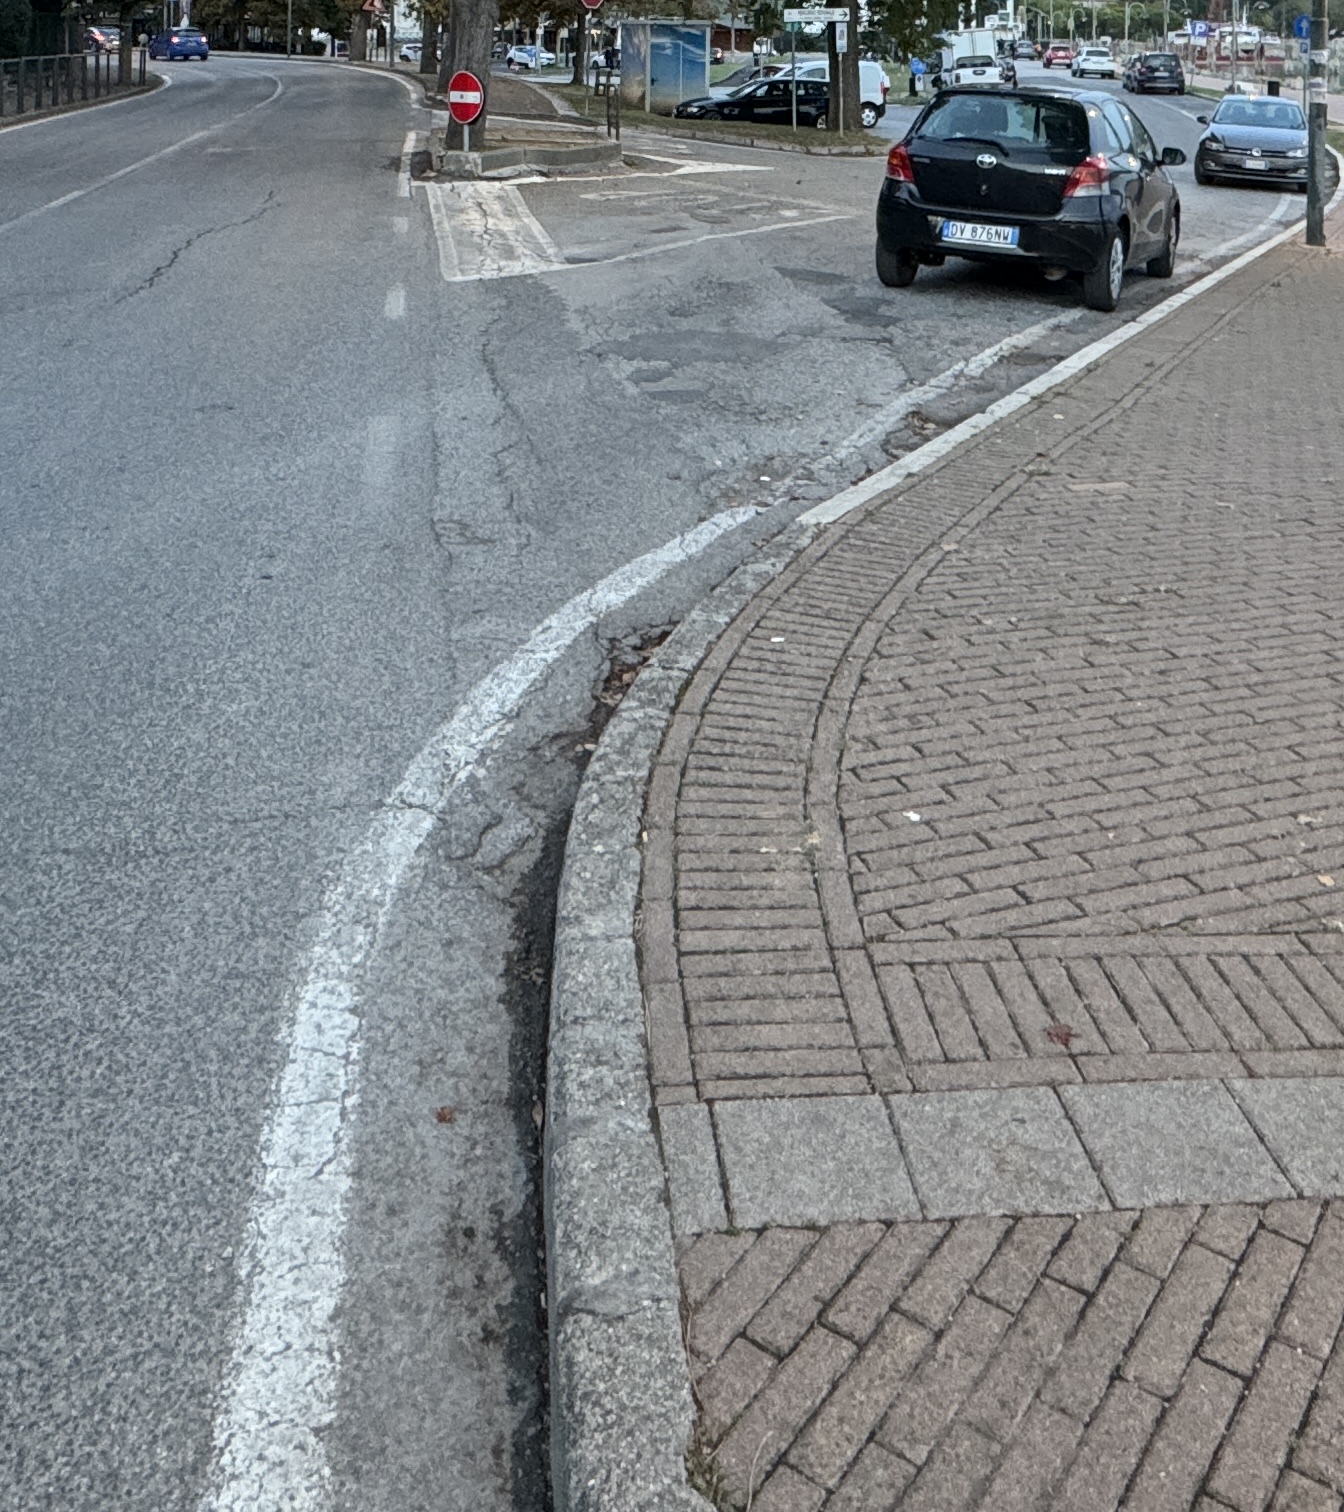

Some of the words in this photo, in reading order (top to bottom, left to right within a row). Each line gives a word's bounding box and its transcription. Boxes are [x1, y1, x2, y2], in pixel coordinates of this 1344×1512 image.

[1195, 23, 1207, 36] P
[950, 222, 967, 238] DV
[970, 226, 1011, 242] 876NW
